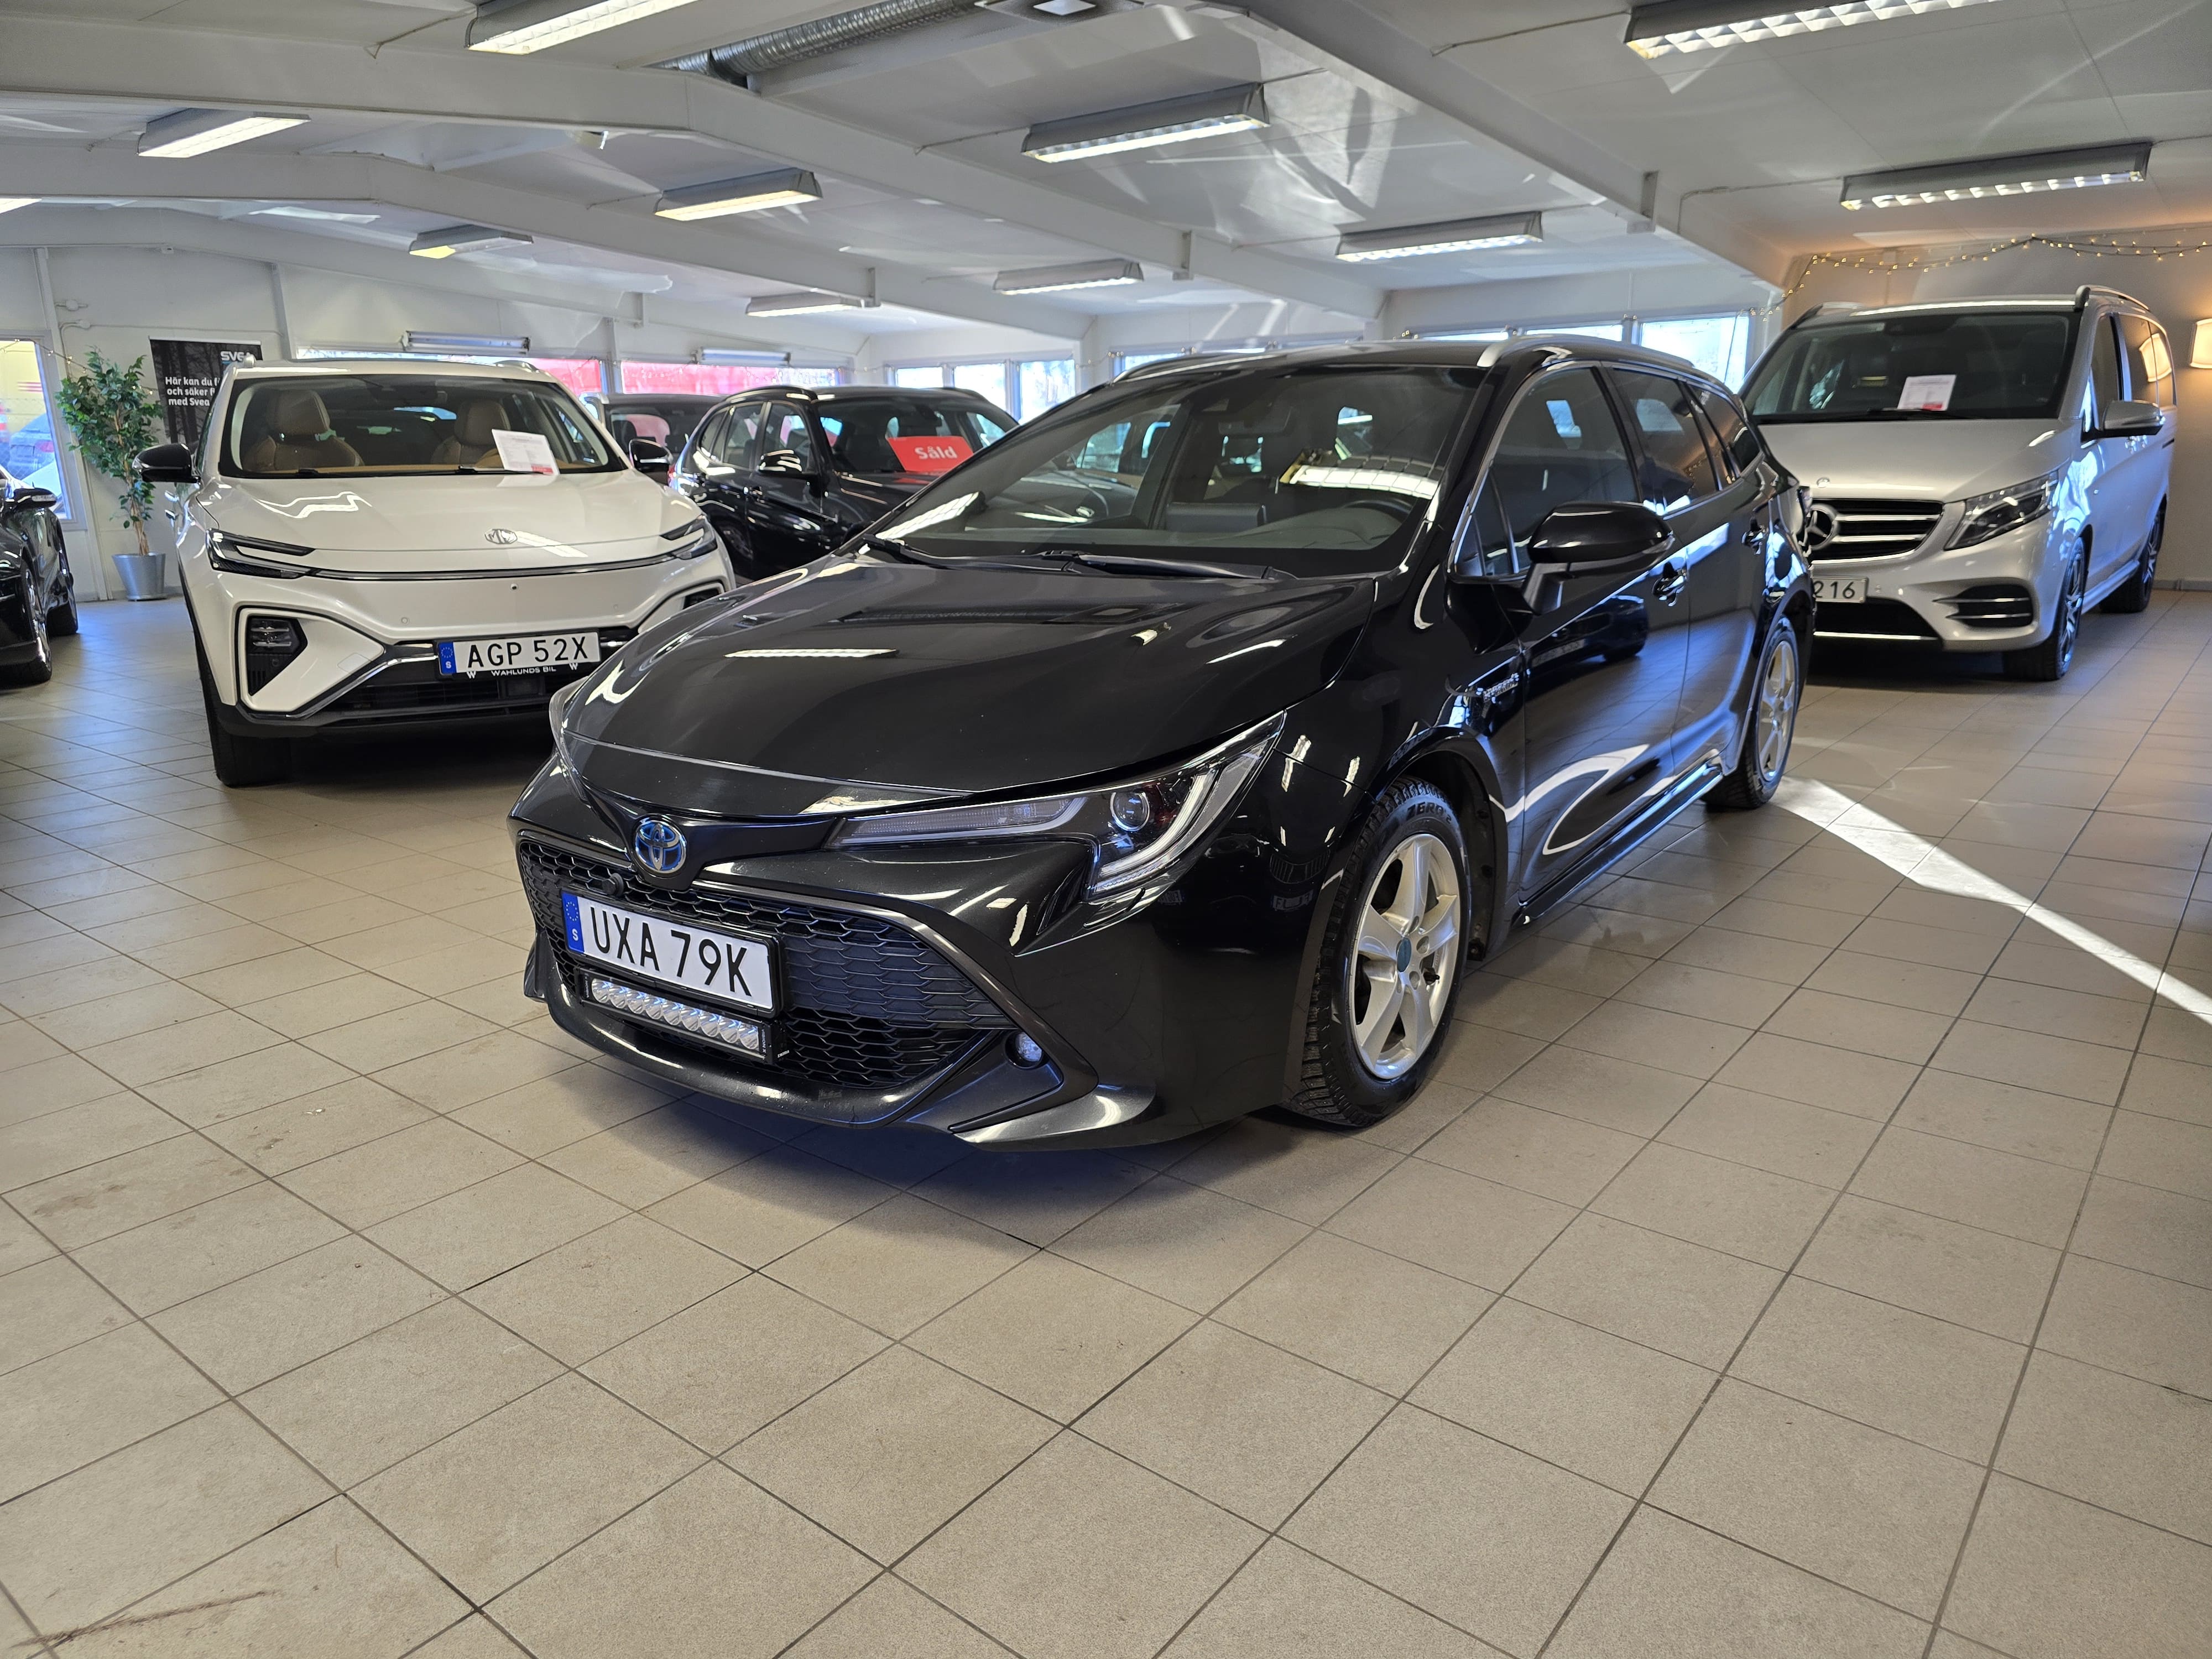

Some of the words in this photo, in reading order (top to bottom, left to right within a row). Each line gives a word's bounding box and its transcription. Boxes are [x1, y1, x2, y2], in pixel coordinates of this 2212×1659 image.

[220, 351, 251, 361] SVE
[165, 377, 181, 385] Här
[183, 377, 199, 386] kan
[201, 377, 212, 386] du
[167, 387, 183, 396] och
[168, 398, 188, 406] med
[189, 398, 210, 406] Svea
[915, 446, 957, 460] Såld
[467, 642, 522, 668] AGP
[533, 637, 588, 662] 52X
[491, 666, 540, 676] WAHLUNDS
[572, 928, 578, 941] S
[590, 906, 660, 971] UXA
[670, 930, 752, 997] 79K
